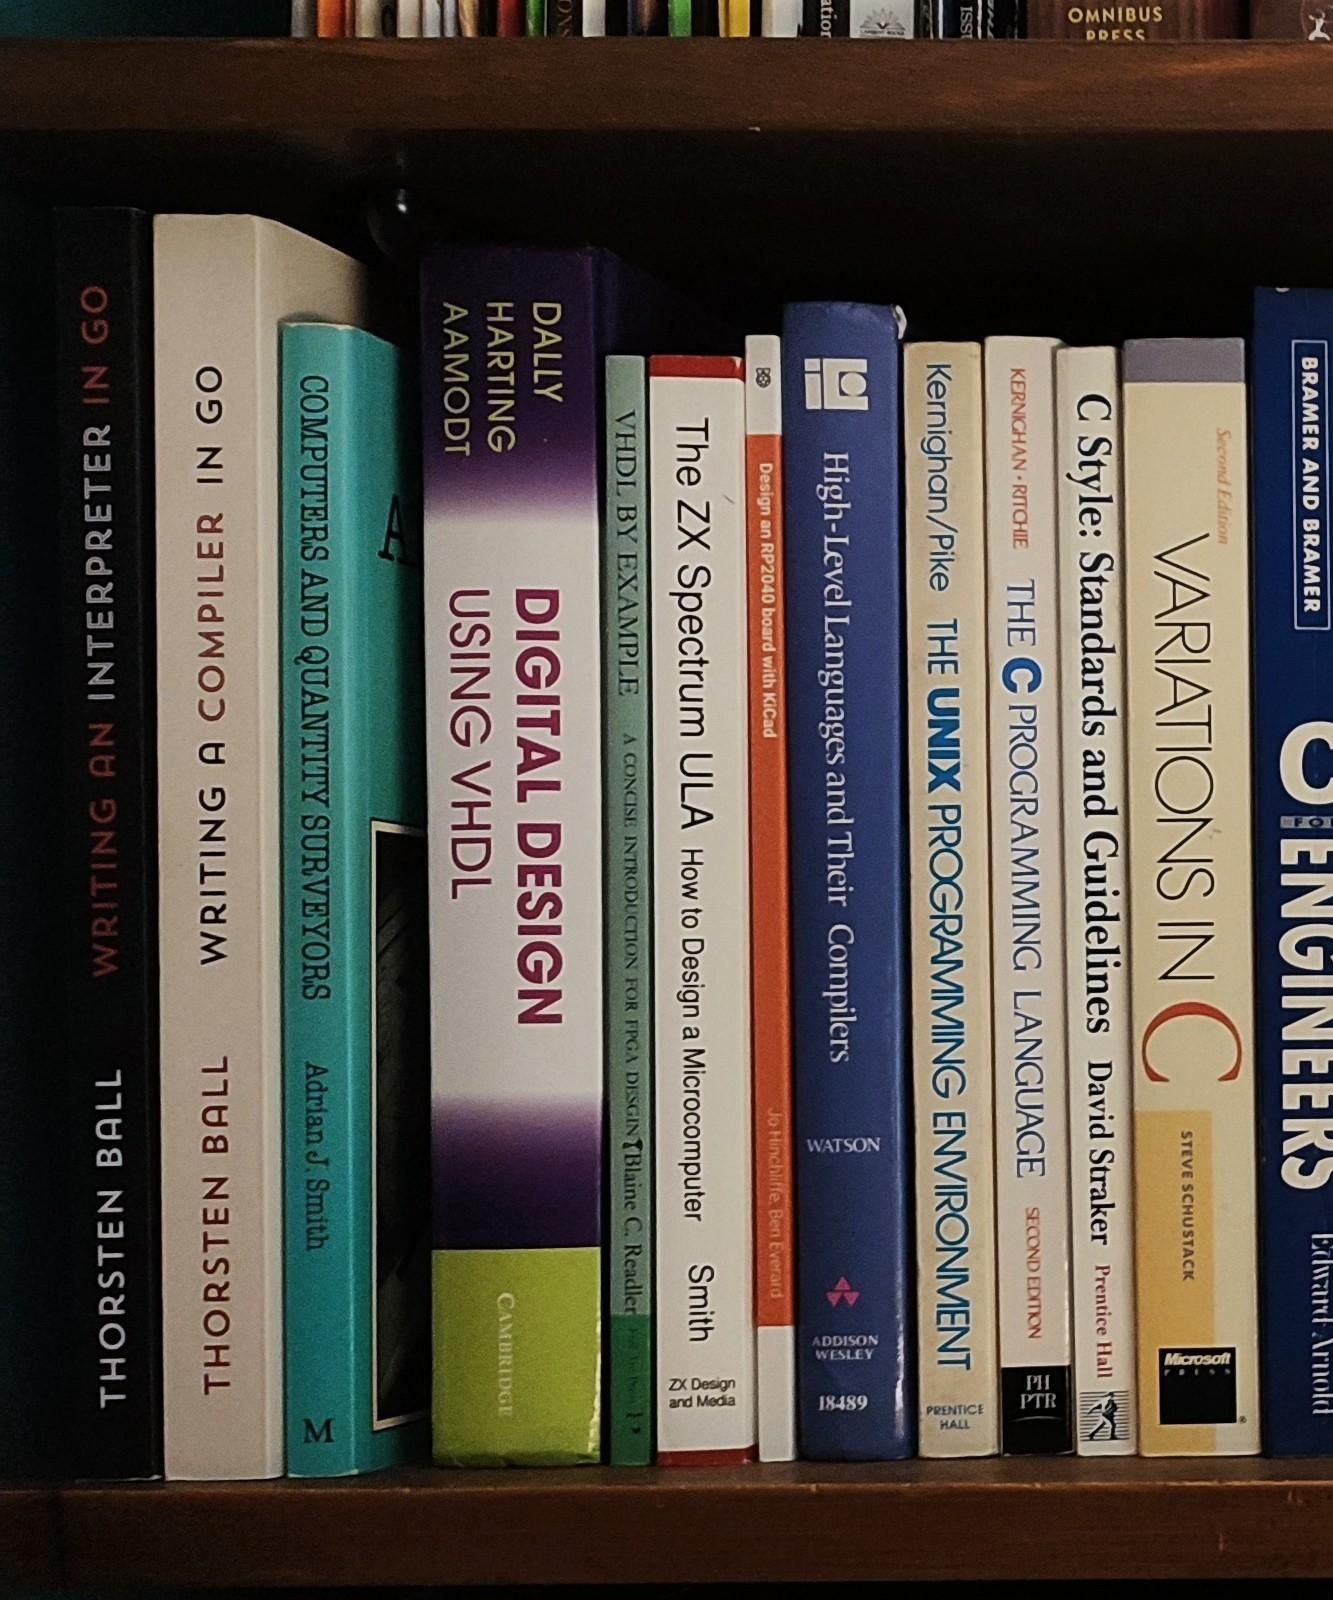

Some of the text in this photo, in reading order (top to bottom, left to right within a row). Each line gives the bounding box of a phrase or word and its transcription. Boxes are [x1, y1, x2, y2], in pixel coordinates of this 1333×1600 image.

[1068, 6, 1163, 24] OMNIBUS
[443, 301, 470, 456] AAMODT
[486, 301, 516, 453] HARTING
[532, 302, 563, 403] DALLY
[615, 410, 639, 696] VHDL BY EXAMPLE
[1215, 428, 1232, 545] Second Edition
[1300, 356, 1322, 613] BRAMER AND BRAMER
[757, 462, 778, 738] Design an RP2040 board with KiCad
[449, 589, 493, 900] USING VHDL
[816, 452, 857, 1064] High-Level Languages and Their Compilers
[1066, 393, 1122, 1034] C Style: Standards and Guidelines
[515, 588, 563, 1026] DIGITAL DESIGN
[926, 619, 971, 1371] THE UNIX PROGRAMMING ENVIRONMENT
[806, 1138, 880, 1153] WATSON
[1086, 1060, 1115, 1246] David Straker
[1180, 1130, 1196, 1282] STEVE SCHUSTACK
[95, 1070, 126, 1409] THORSTEN BALL
[201, 1056, 231, 1396] THORSTEN BALL
[1025, 1206, 1043, 1339] SECOND EDITION
[688, 1264, 714, 1343] Smith
[811, 1334, 879, 1347] ADDISON
[814, 1348, 874, 1361] WESLEY
[1093, 1264, 1113, 1379] Prentice Hall
[1164, 1352, 1232, 1366] Microsoft
[669, 1379, 736, 1391] ZX Design
[818, 1395, 868, 1411] 18489
[926, 1405, 985, 1416] PRENTICE
[940, 1420, 971, 1431] HALL
